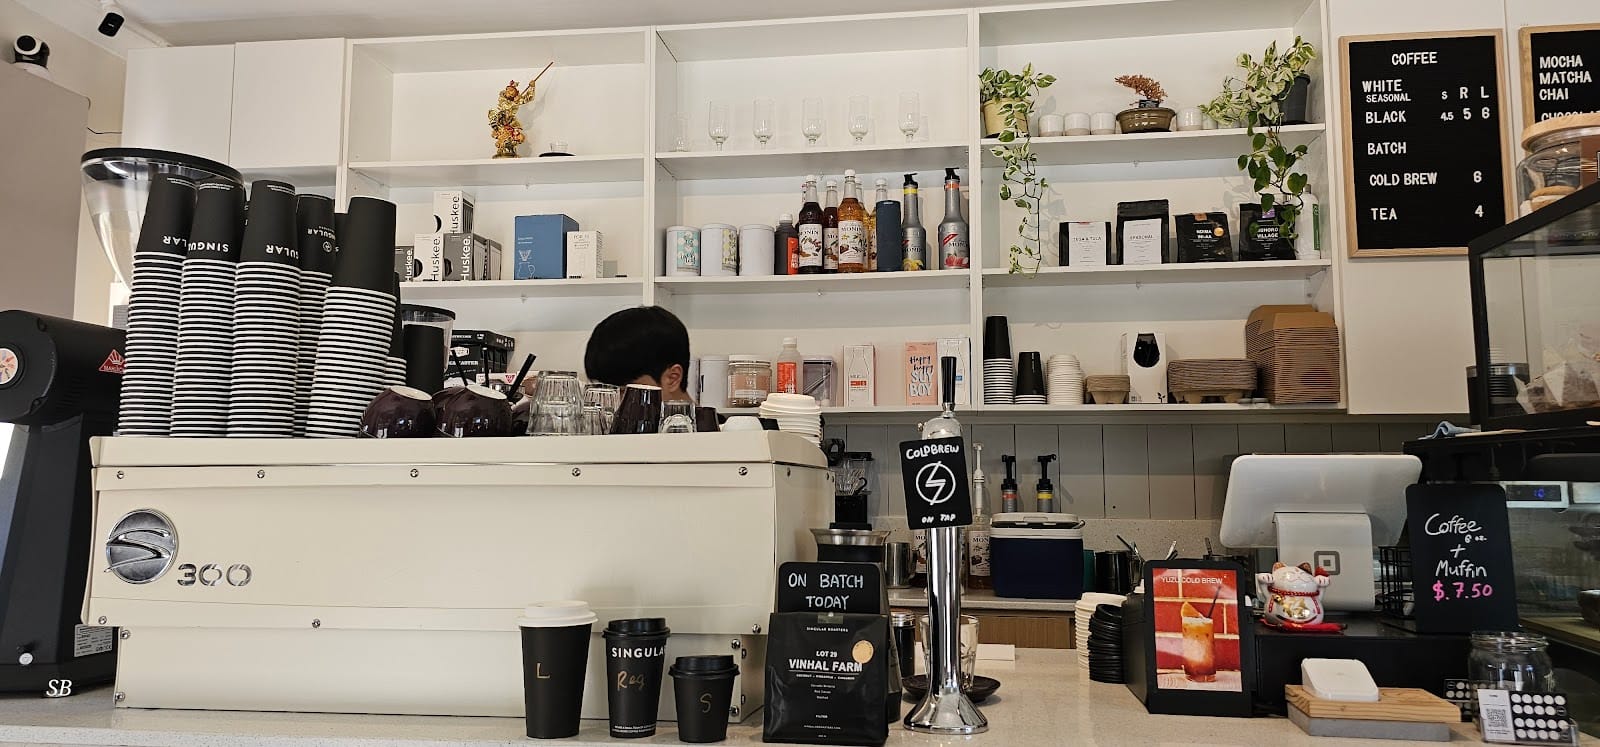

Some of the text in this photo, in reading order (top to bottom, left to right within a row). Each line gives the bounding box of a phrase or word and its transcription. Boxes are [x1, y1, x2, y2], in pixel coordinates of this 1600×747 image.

[1391, 51, 1438, 66] COFFEE
[1539, 54, 1584, 69] MOCHA
[1539, 70, 1593, 85] MATCHA
[1362, 79, 1403, 93] WHITE
[1459, 86, 1469, 99] R
[1480, 86, 1490, 98] L
[1366, 93, 1412, 103] SEASONAL
[1539, 87, 1569, 101] CHAI
[1365, 110, 1407, 124] BLACK
[1462, 107, 1472, 120] 5
[1481, 106, 1490, 119] 6
[1367, 142, 1407, 155] BATCH
[1369, 170, 1483, 187] COLD BREW 6
[1370, 204, 1484, 220] TEA 4
[908, 383, 932, 397] BOY
[921, 513, 956, 524] ON TAP
[1424, 512, 1482, 536] Coffee
[177, 563, 253, 587] 300
[1435, 559, 1488, 578] Muffin
[788, 572, 864, 589] ON BATCH
[1180, 576, 1201, 584] COLD
[1201, 577, 1223, 585] BREW
[805, 594, 850, 611] TODAY
[536, 663, 551, 679] L
[788, 658, 863, 673] VINHAL FARM
[699, 693, 713, 713] S
